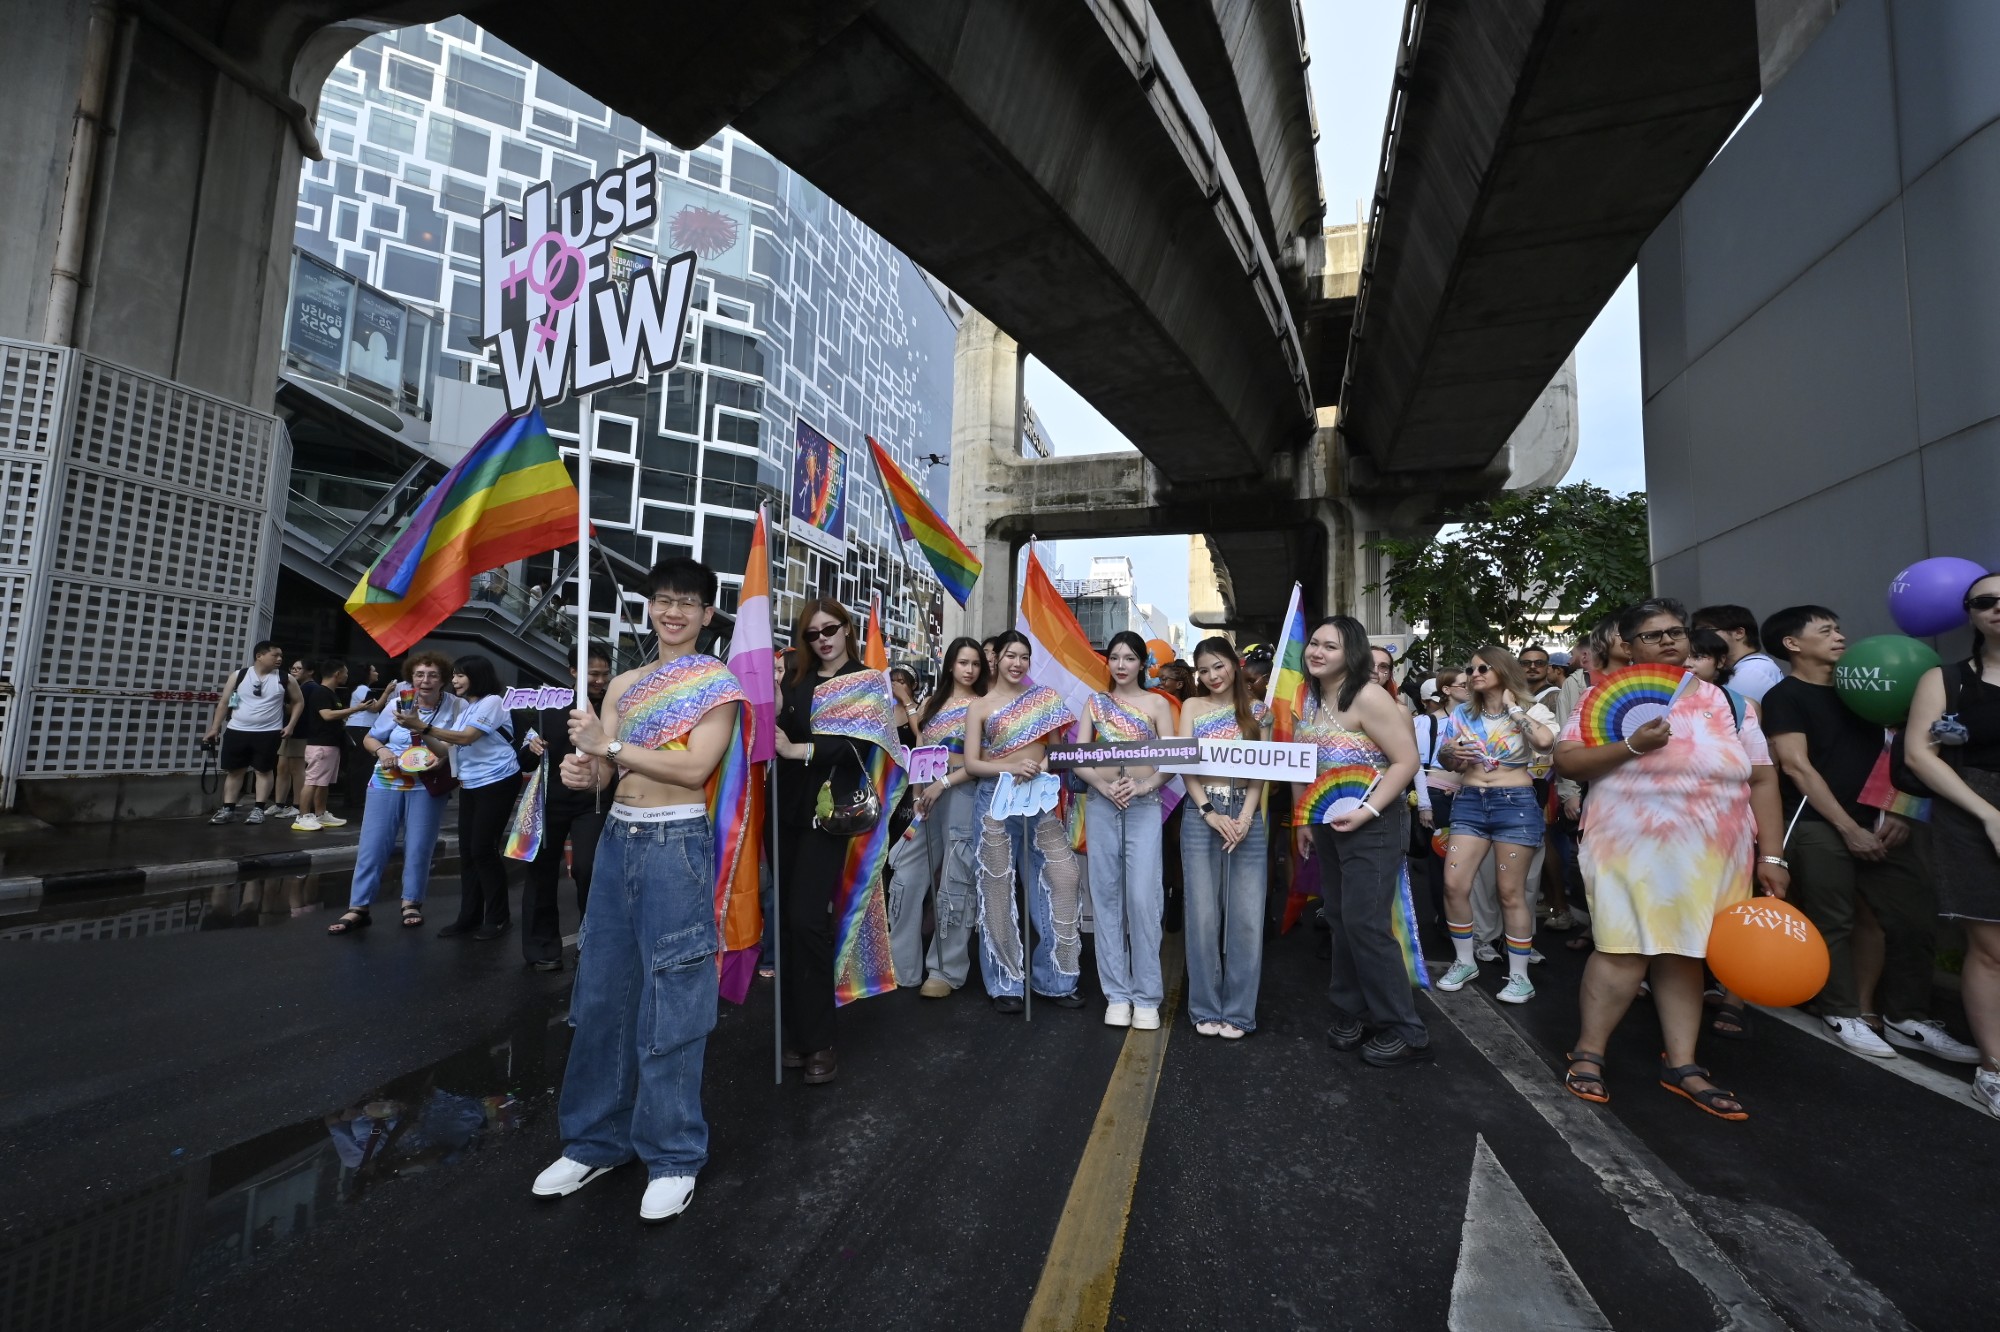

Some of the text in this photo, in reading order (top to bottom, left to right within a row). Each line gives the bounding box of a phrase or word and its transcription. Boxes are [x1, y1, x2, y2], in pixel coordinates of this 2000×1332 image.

[498, 258, 692, 411] WLW
[1836, 666, 1881, 679] SIAM
[1836, 678, 1897, 691] PIWAT
[1199, 746, 1311, 768] LWCOUPLE
[642, 811, 661, 819] Calvin
[1730, 906, 1806, 931] PIWAT
[1743, 914, 1807, 942] SIAM
